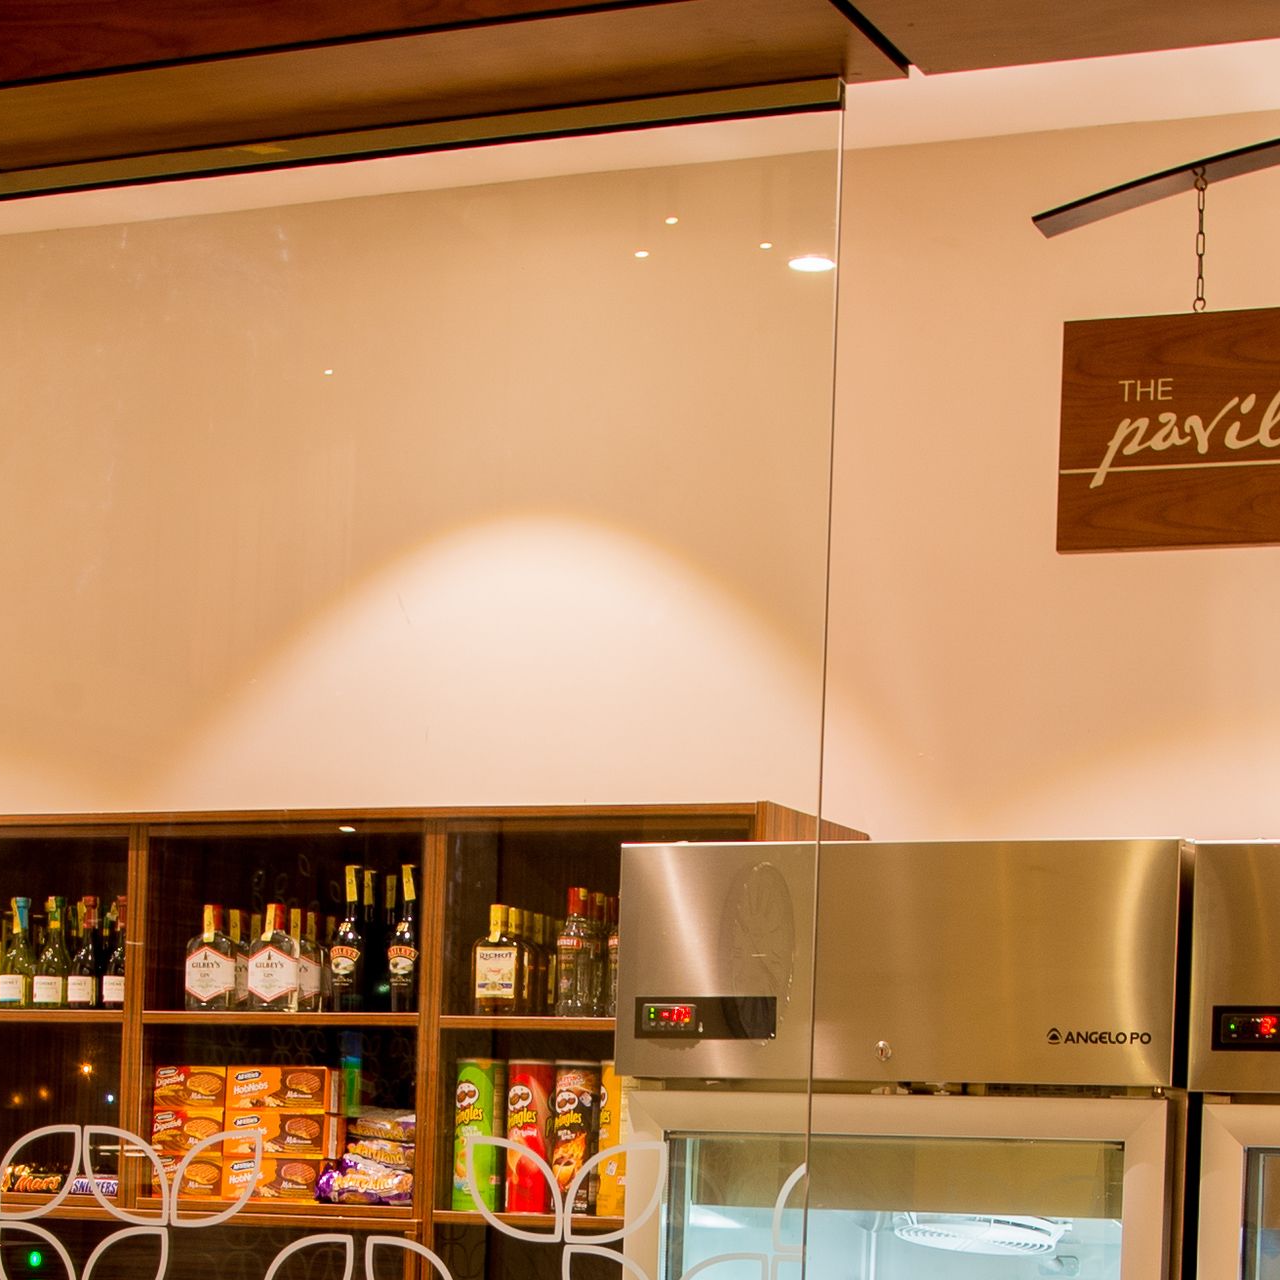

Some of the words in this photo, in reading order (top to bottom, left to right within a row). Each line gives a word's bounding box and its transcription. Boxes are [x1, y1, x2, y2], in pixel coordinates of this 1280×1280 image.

[1118, 377, 1174, 402] THE
[1064, 1031, 1127, 1045] ANGELO
[1130, 1032, 1152, 1045] PO
